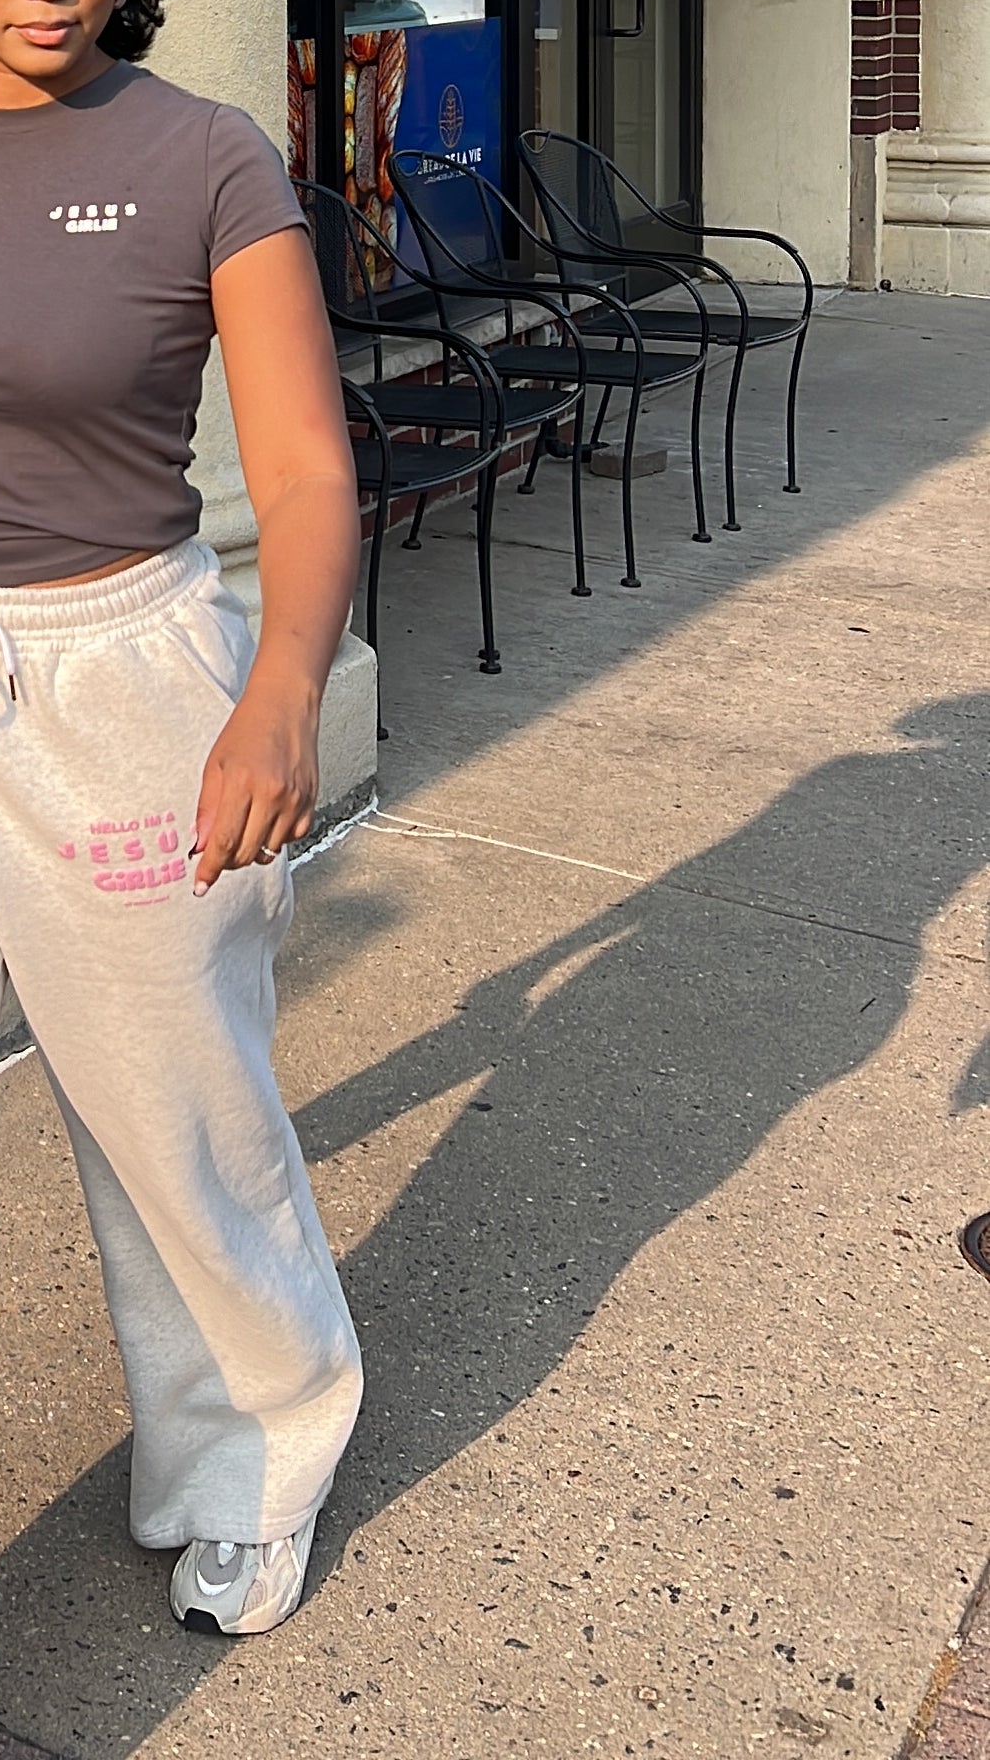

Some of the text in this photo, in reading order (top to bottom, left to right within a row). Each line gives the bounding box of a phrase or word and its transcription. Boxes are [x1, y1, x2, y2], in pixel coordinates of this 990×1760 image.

[468, 147, 482, 163] VIE
[90, 821, 140, 834] HELLO
[165, 811, 176, 823] A
[58, 823, 197, 864] JESU
